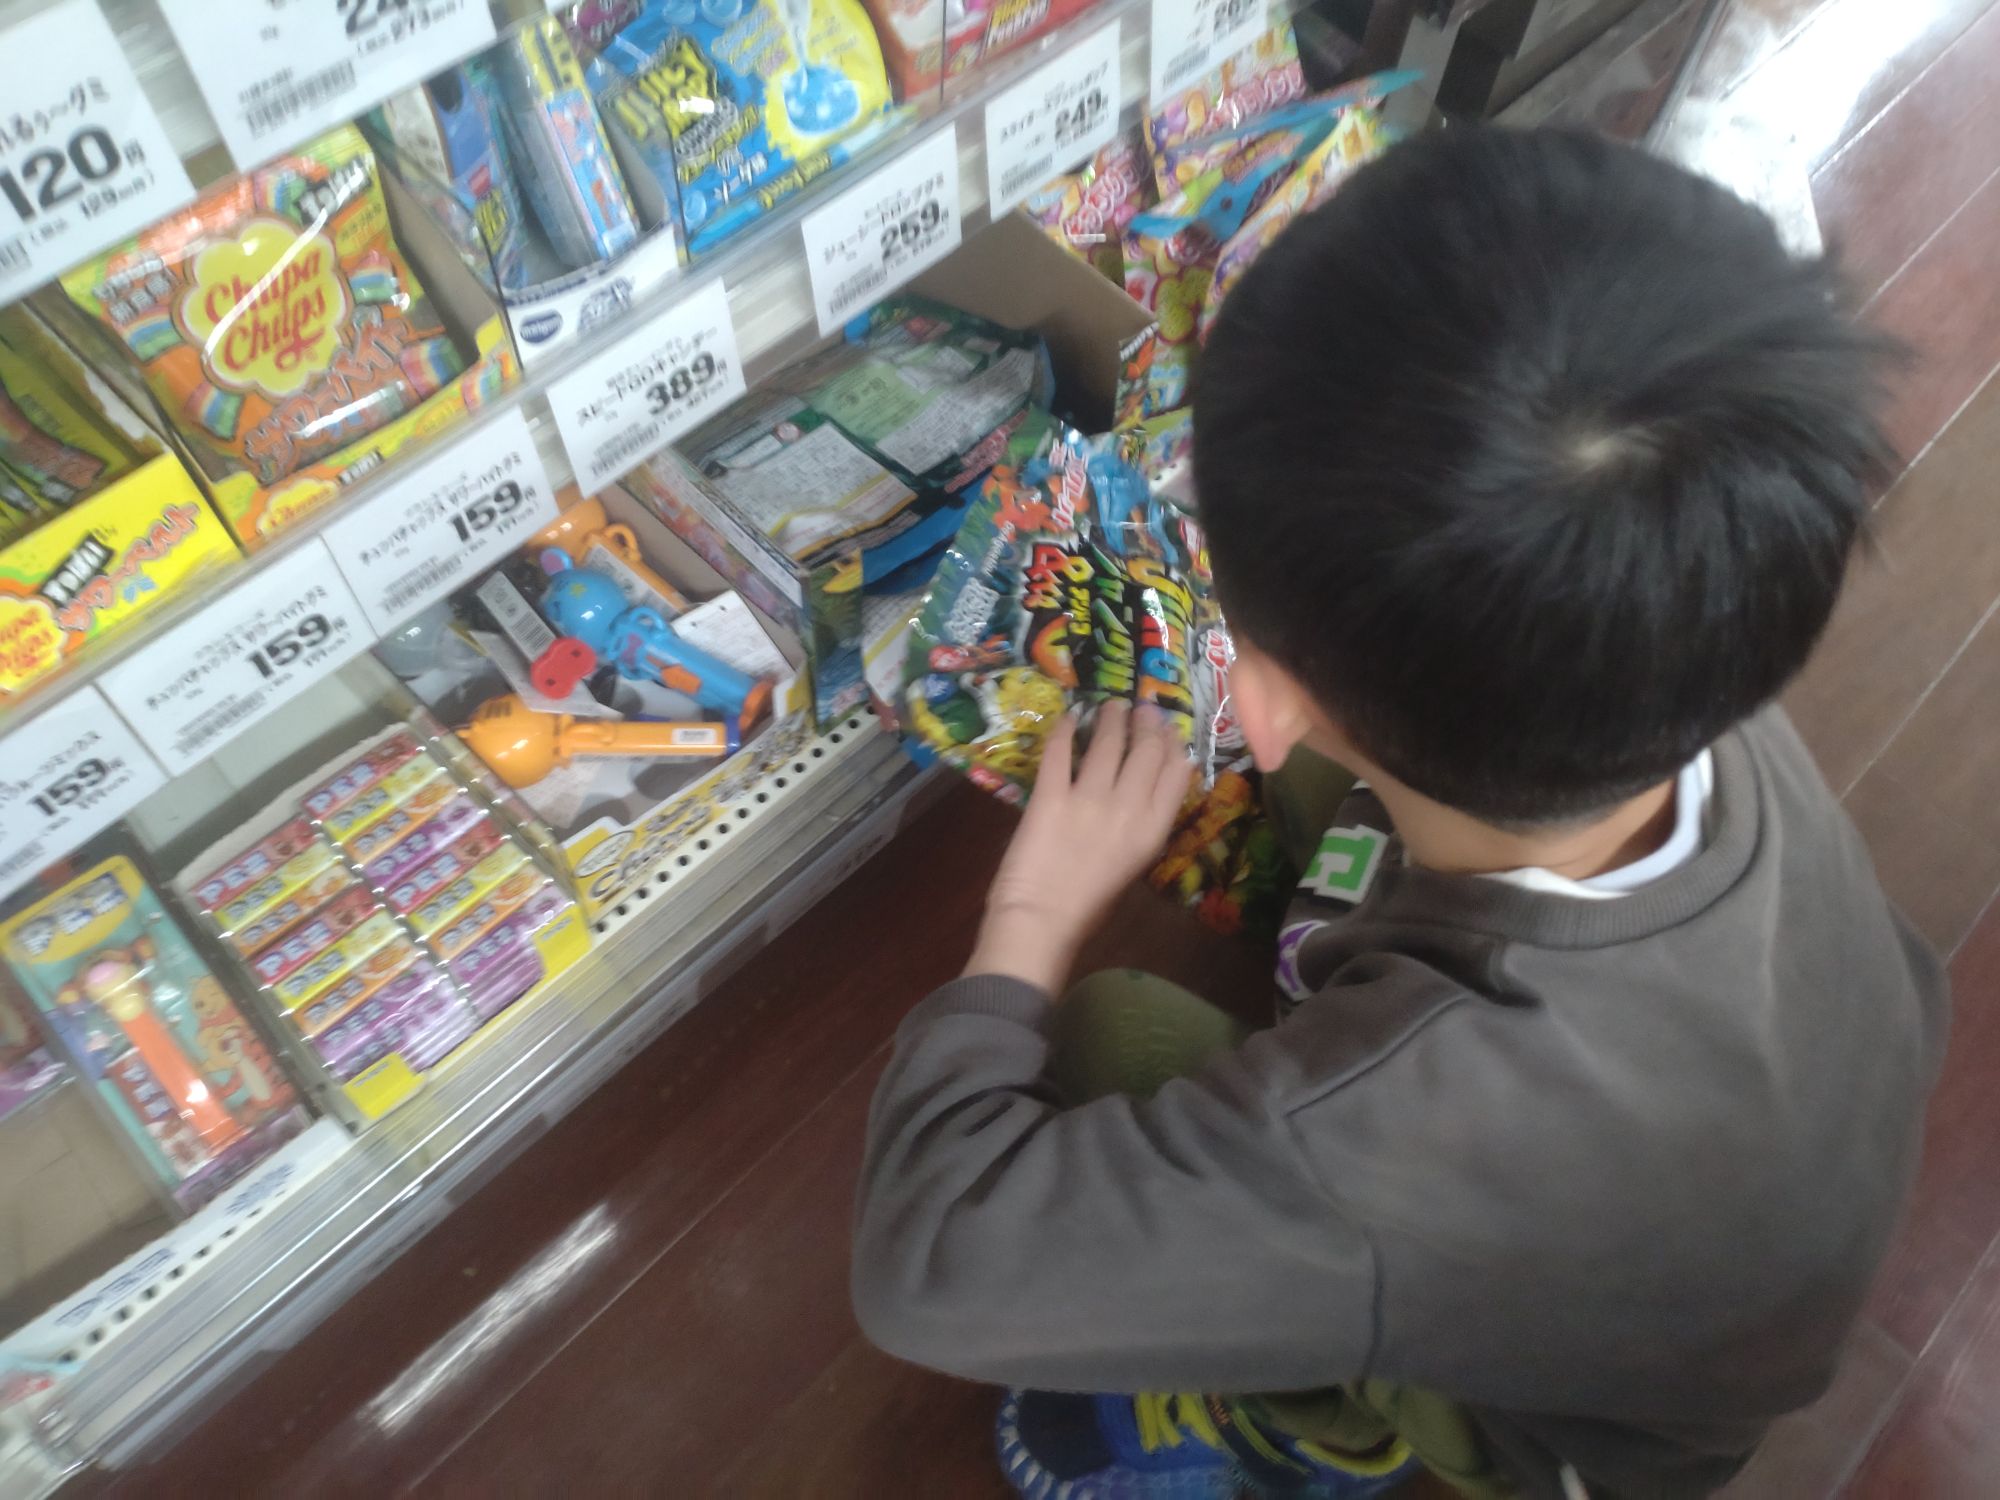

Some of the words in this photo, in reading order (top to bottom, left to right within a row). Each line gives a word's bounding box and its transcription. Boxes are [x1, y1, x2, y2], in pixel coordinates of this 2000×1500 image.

[204, 246, 323, 318] Chupa
[223, 285, 328, 372] Chups
[305, 759, 377, 814] PEZ
[333, 787, 390, 831] PEZ
[352, 809, 412, 856] PEZ
[370, 830, 431, 878] PEZ
[195, 849, 272, 908] PEZ
[225, 875, 285, 921] PEZ
[389, 852, 462, 908] PEZ
[415, 877, 477, 926] PEZ
[241, 900, 302, 947] PEZ
[437, 901, 499, 950] PEZ
[254, 919, 333, 980] PEZ
[457, 924, 519, 973] PEZ
[283, 949, 347, 998] PEZ
[302, 974, 368, 1026] PEZ
